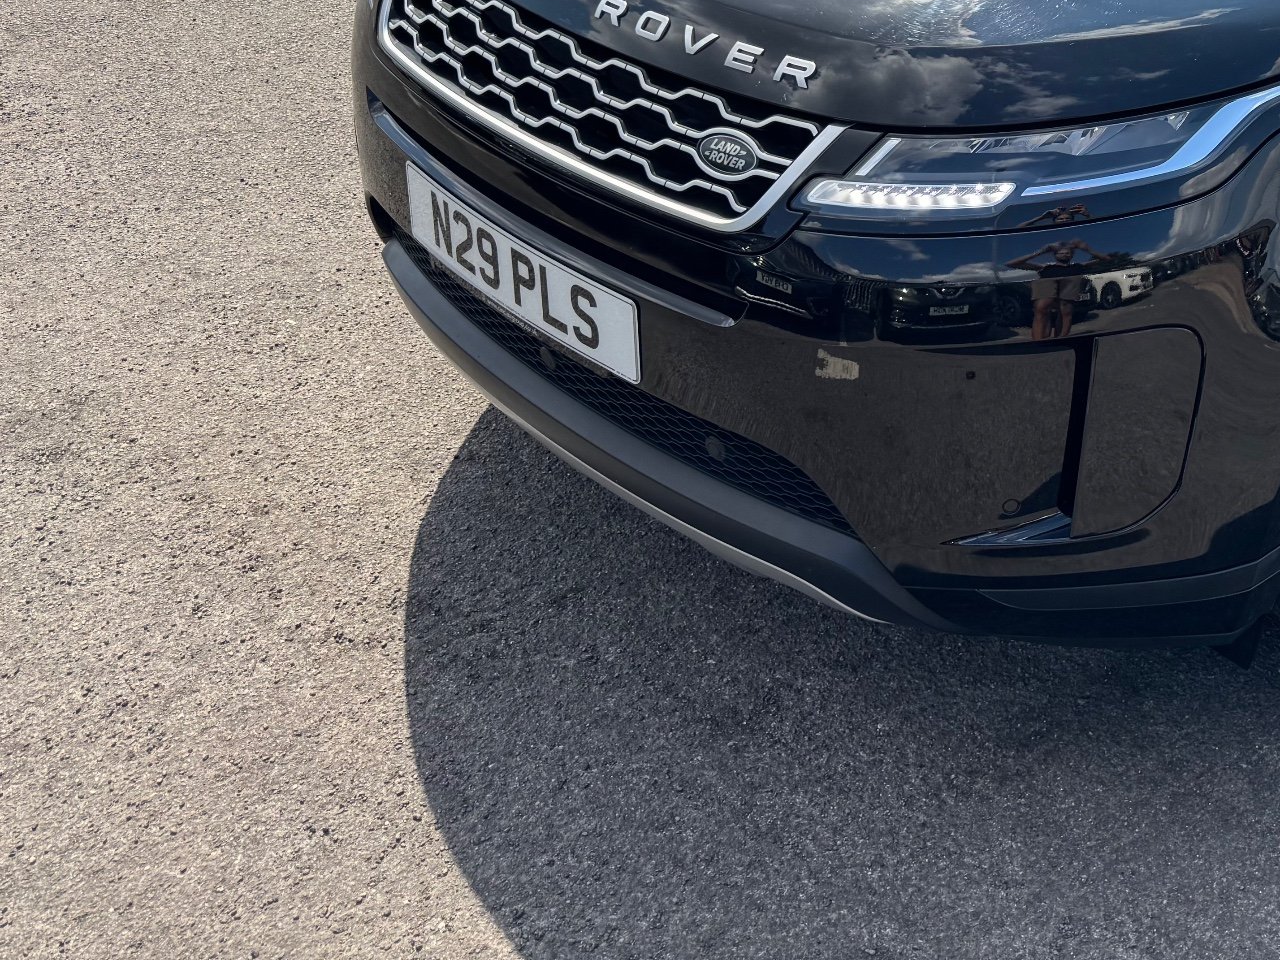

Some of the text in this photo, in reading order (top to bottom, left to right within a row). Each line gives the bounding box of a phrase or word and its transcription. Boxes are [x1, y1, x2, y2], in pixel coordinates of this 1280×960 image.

[710, 138, 741, 156] LAND
[708, 150, 746, 170] ROVER
[430, 189, 600, 350] N29 PLS
